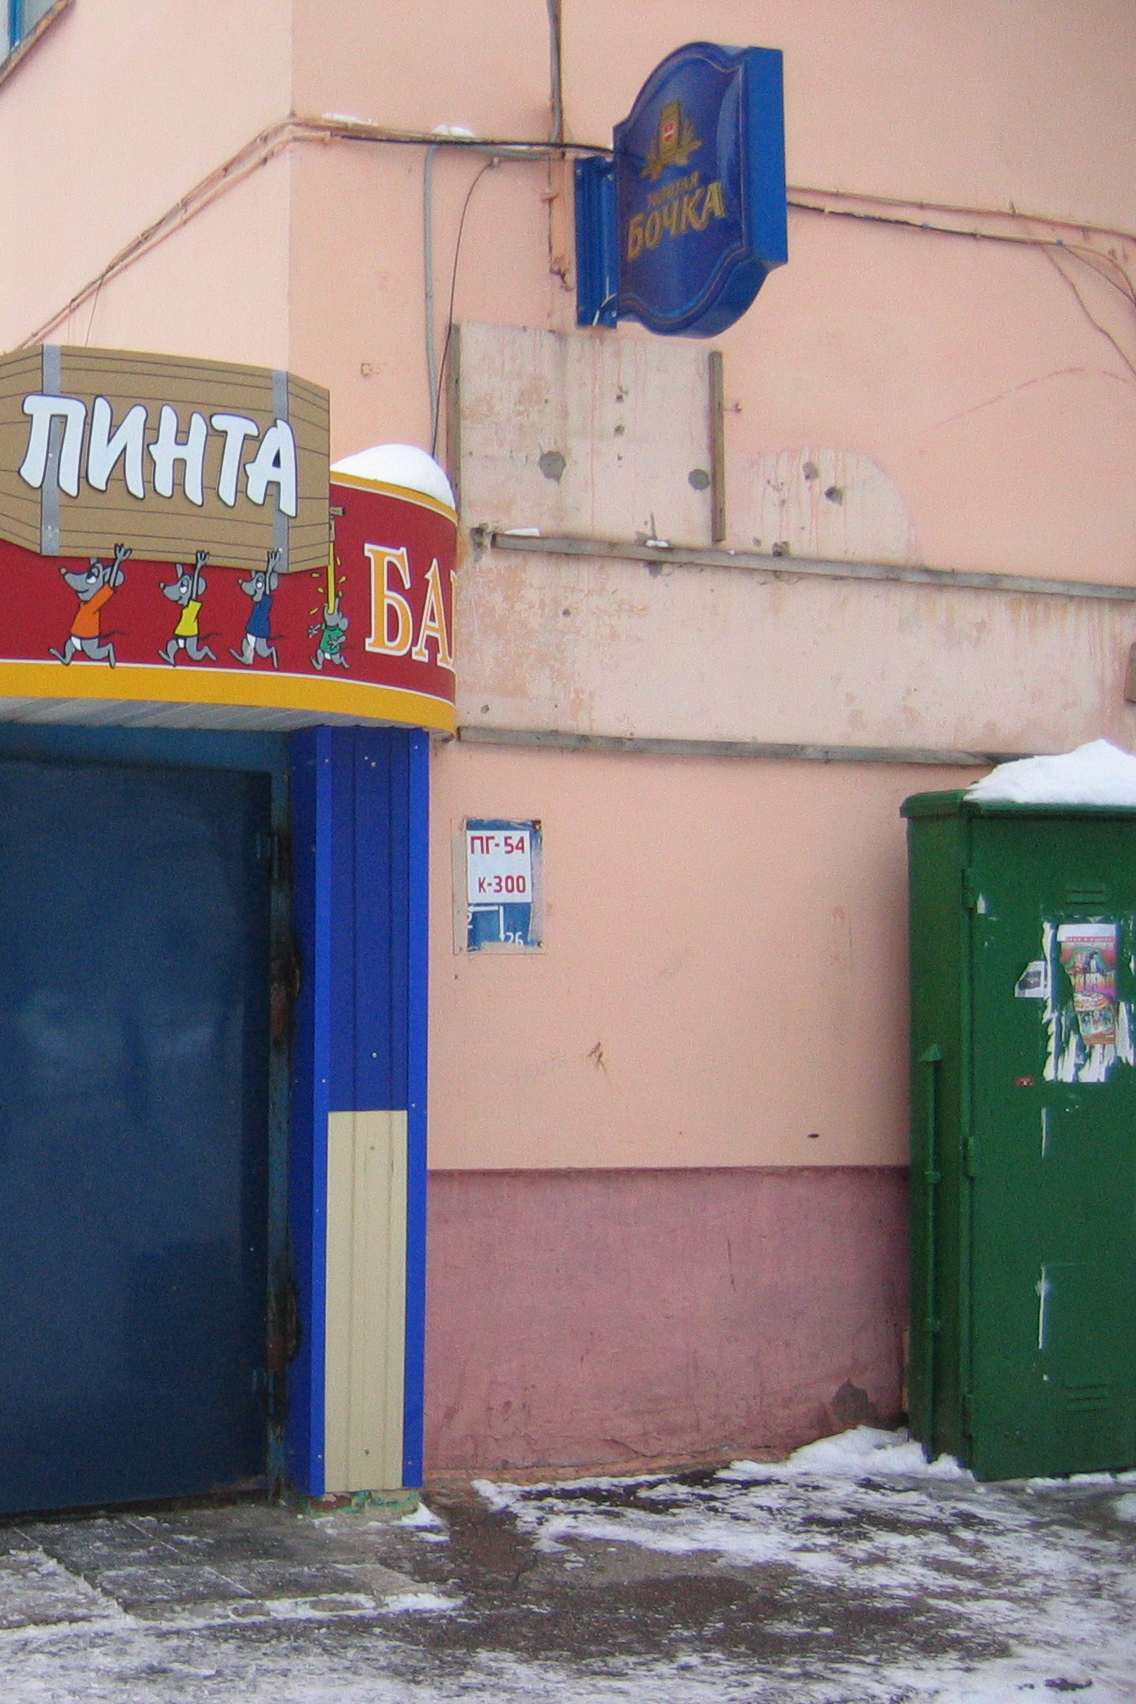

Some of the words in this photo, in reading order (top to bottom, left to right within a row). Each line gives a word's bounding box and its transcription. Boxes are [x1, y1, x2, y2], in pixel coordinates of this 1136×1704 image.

[626, 182, 725, 262] БОЧКА
[18, 394, 297, 518] ПИНТА
[363, 542, 456, 673] БА
[470, 836, 525, 854] ПГ-54
[478, 875, 526, 893] К-300
